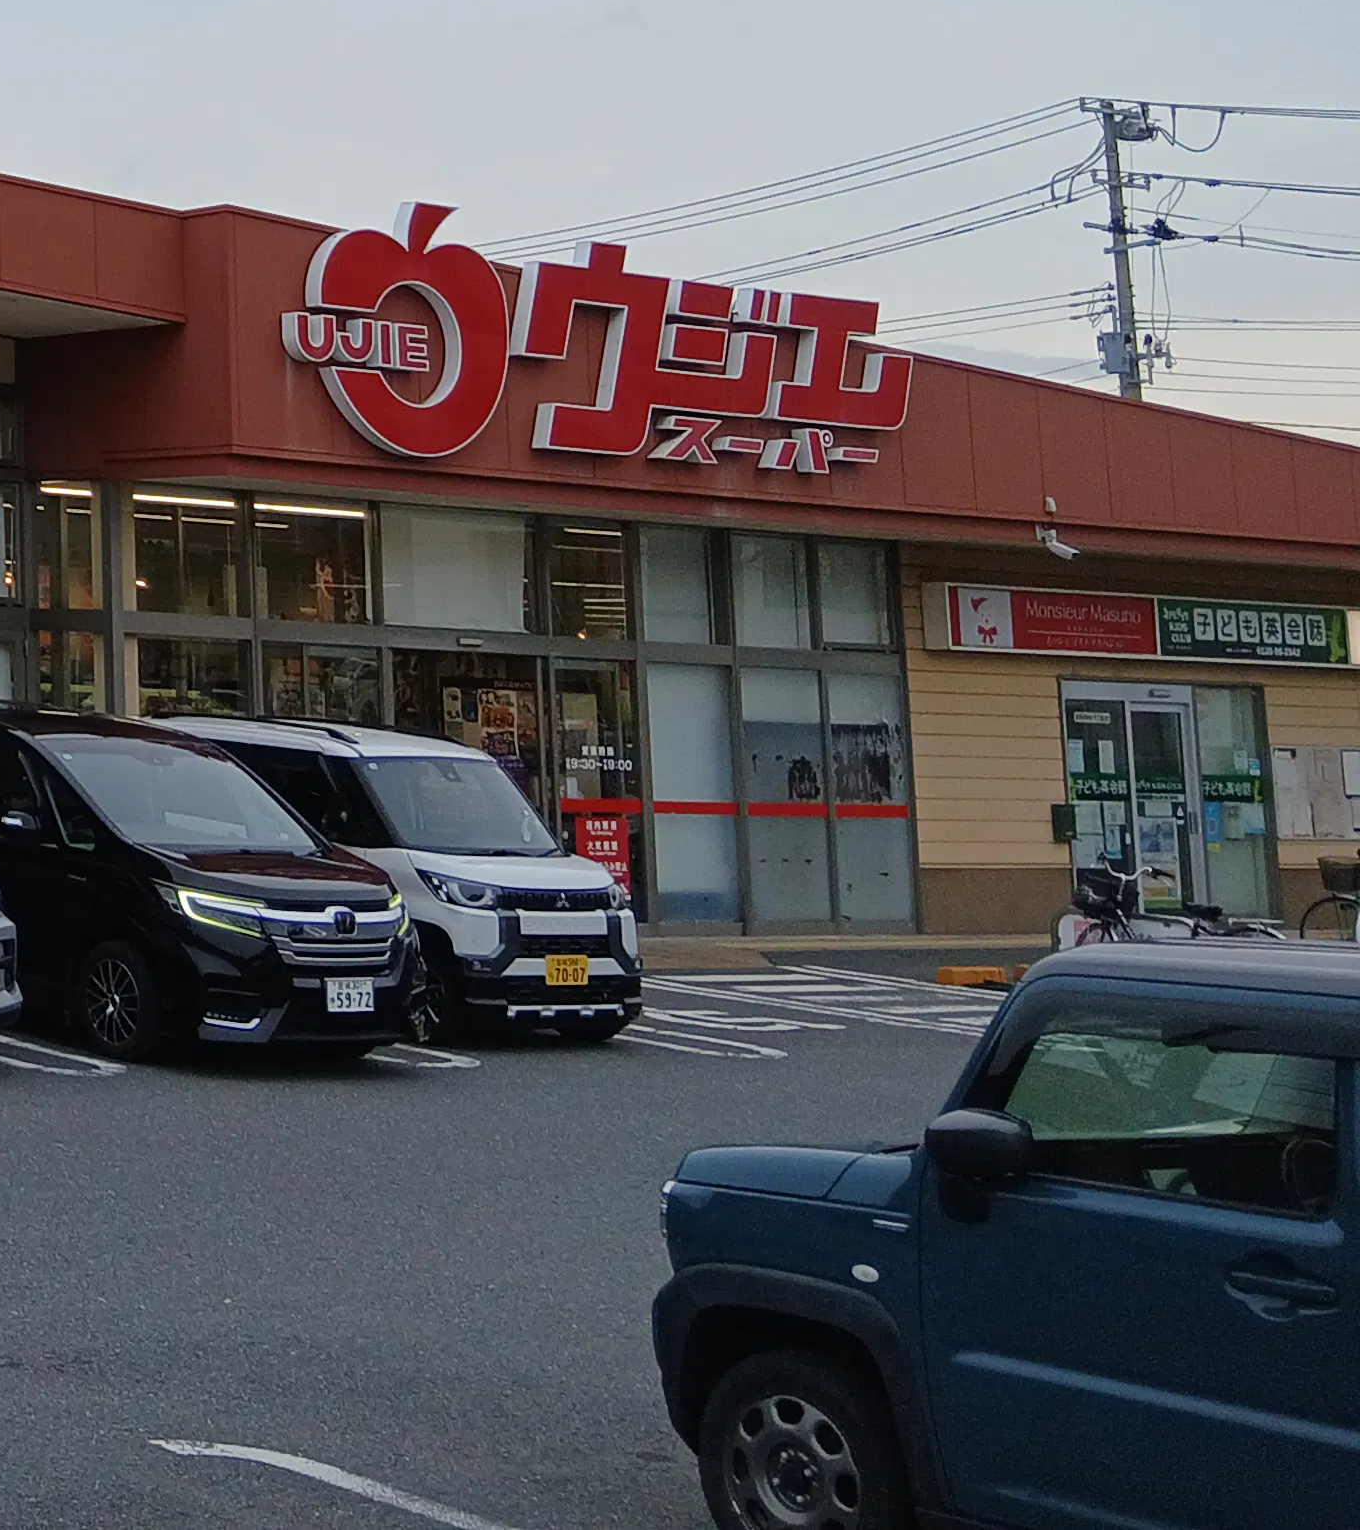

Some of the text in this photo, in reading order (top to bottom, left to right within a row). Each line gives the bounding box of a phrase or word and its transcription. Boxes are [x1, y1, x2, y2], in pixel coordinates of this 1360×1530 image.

[286, 311, 430, 373] UJIE
[510, 241, 913, 456] ウジエ
[648, 414, 879, 474] スーパー
[1025, 599, 1088, 621] Monsieur
[1090, 602, 1142, 624] Masuno
[1195, 610, 1325, 645] 子ども英会話
[1076, 778, 1128, 795] 子ども英会話
[555, 967, 586, 983] 70-07
[336, 991, 373, 1008] 59-72
